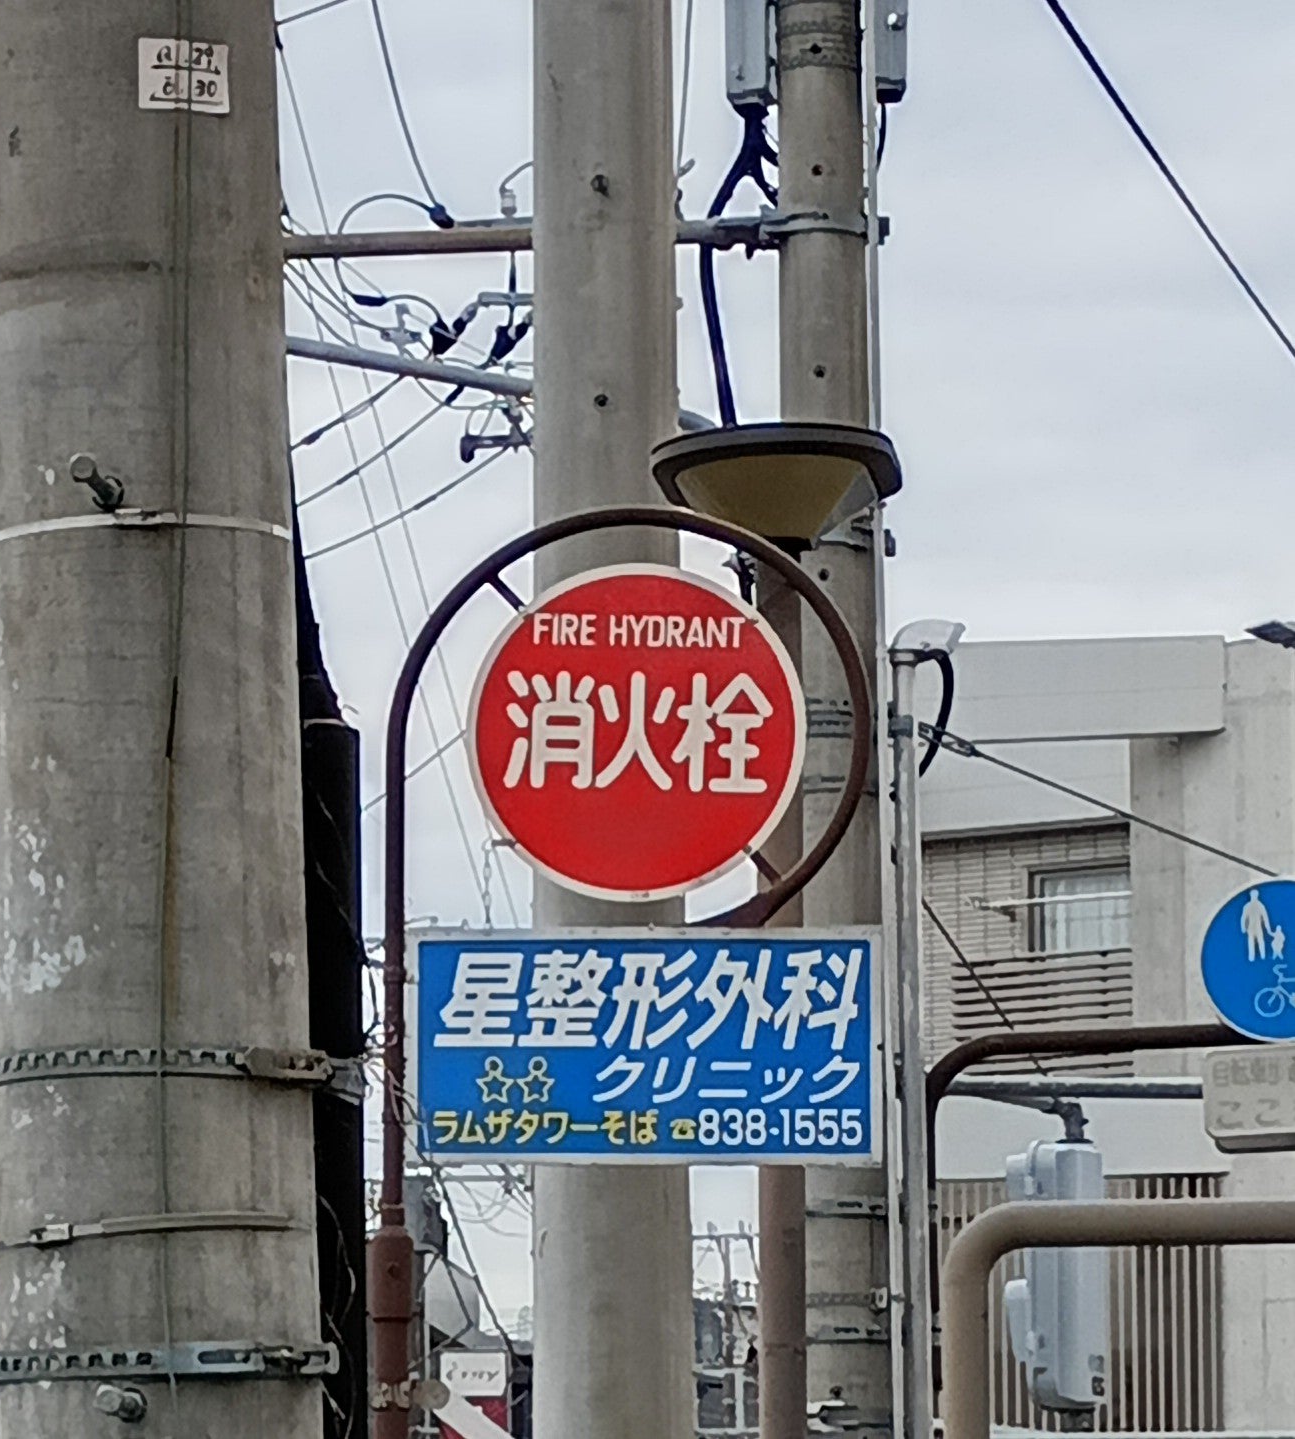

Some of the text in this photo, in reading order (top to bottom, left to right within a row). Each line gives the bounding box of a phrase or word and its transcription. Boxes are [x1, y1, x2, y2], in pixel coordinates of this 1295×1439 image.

[533, 612, 747, 648] FIRE HYDRANT
[503, 670, 774, 794] 消火栓
[433, 948, 863, 1051] 星整形外科
[593, 1054, 861, 1104] クリニック
[433, 1108, 659, 1144] ラムザタワーそば
